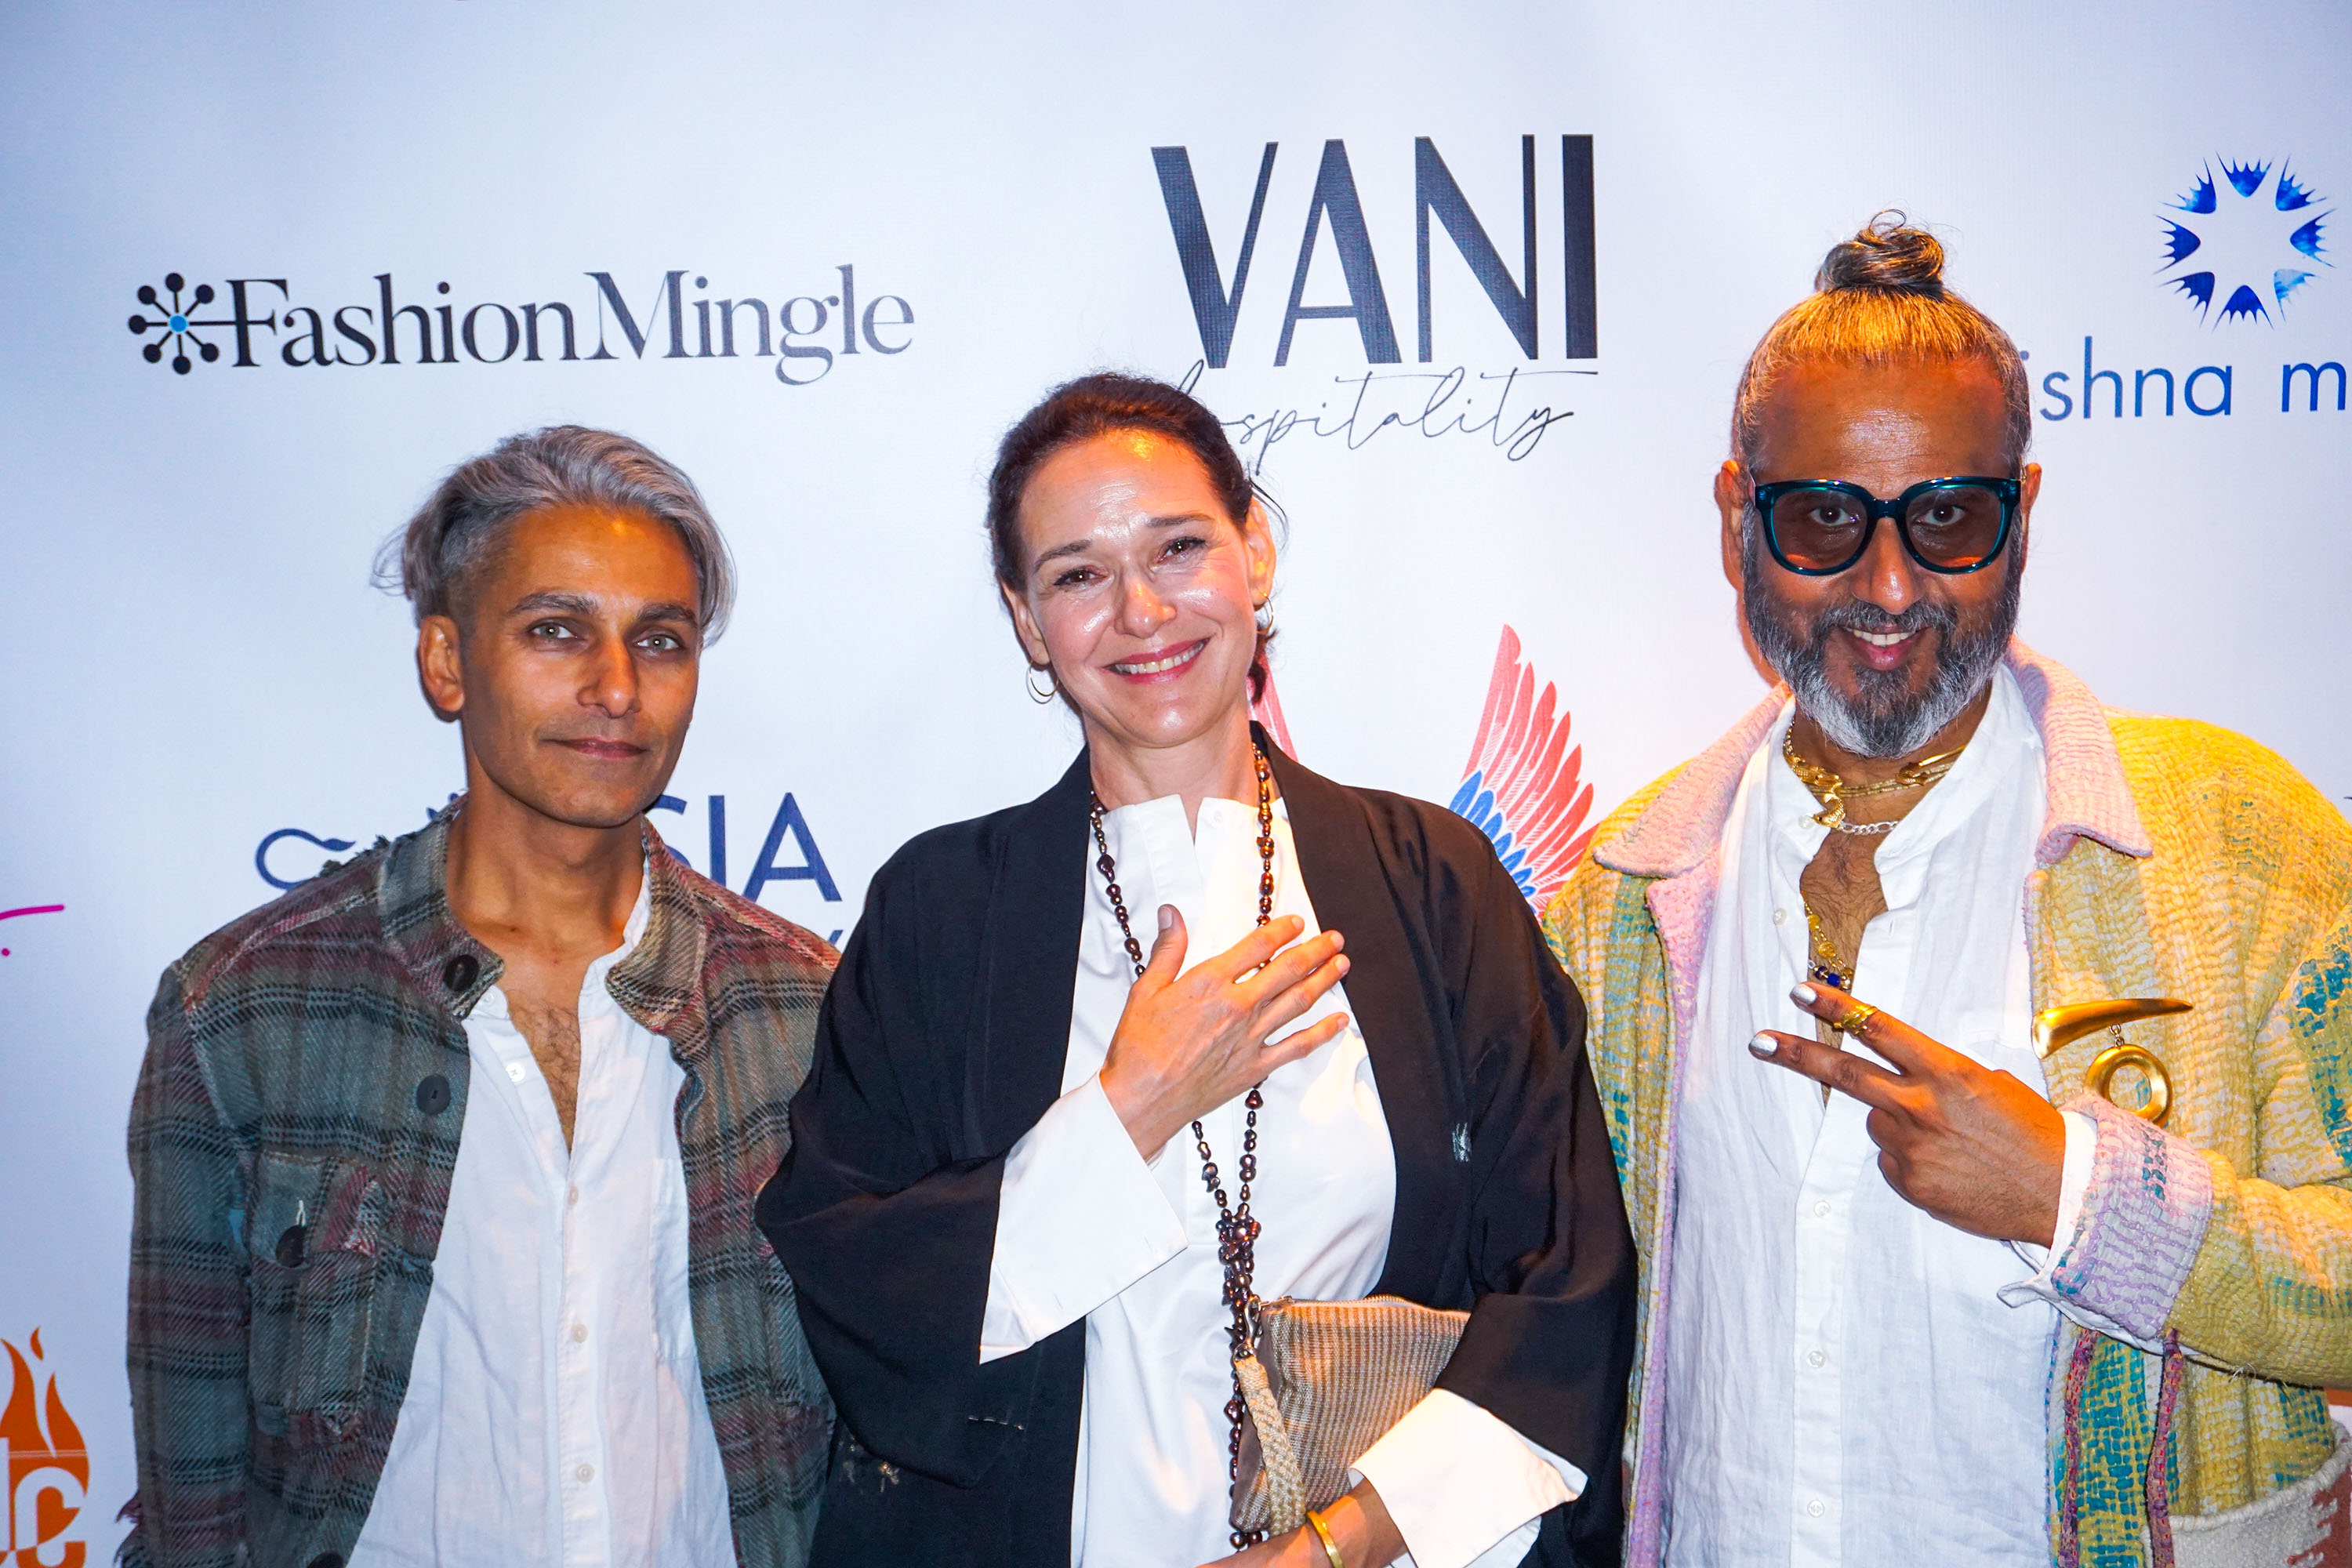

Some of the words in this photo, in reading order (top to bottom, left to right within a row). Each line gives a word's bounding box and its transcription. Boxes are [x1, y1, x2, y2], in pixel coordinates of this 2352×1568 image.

[1151, 134, 1599, 368] VANI
[1178, 359, 1599, 476] spitality
[2020, 336, 2233, 422] shna
